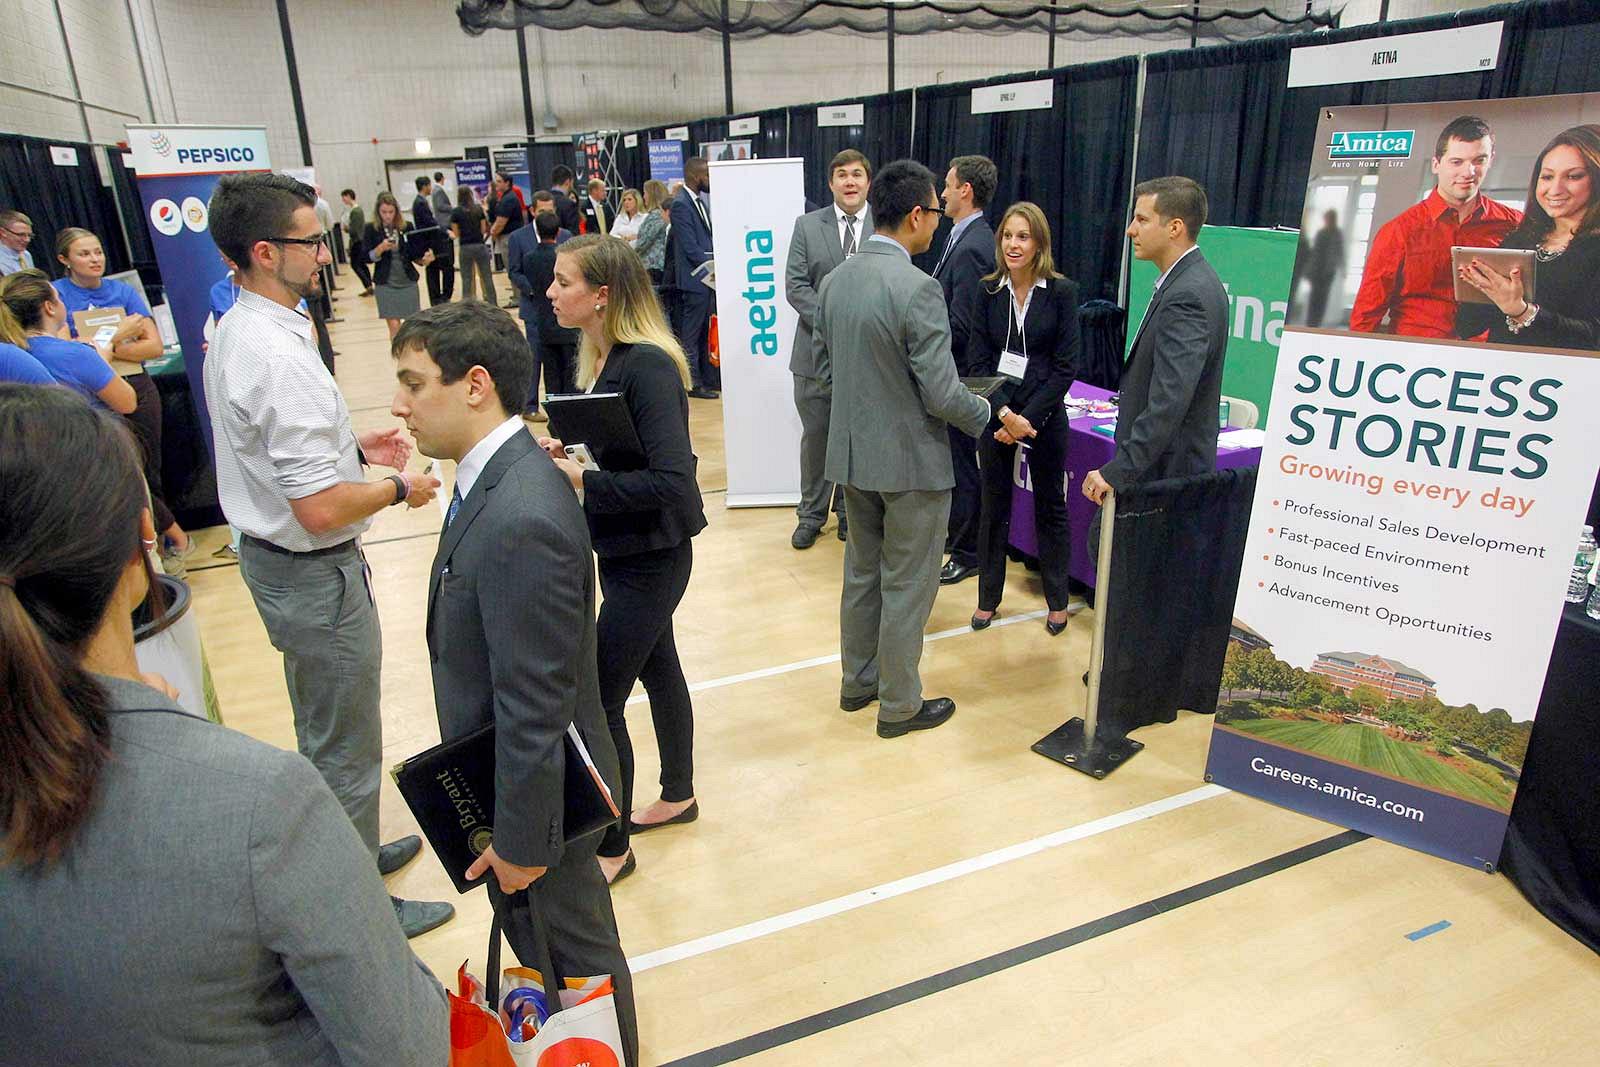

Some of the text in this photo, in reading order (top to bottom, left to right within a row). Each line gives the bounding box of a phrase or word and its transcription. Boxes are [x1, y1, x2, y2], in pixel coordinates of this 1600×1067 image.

[1371, 50, 1398, 65] AETNA
[176, 147, 255, 164] PEPSICO
[1331, 131, 1407, 152] Amica
[742, 229, 778, 357] aetna
[1293, 354, 1564, 422] SUCCESS
[1284, 404, 1555, 480] STORIES
[1279, 454, 1536, 518] Growing every day
[1279, 527, 1471, 577] Fast-paced Environment
[1284, 498, 1374, 529] Professional
[1378, 517, 1421, 537] Sales
[1425, 525, 1547, 559] Development
[1274, 554, 1400, 594] Bonus Incentives
[1268, 581, 1493, 642] Advancement Opportunities
[436, 770, 477, 829] Bryant
[1250, 756, 1425, 822] Careers.amica.com
